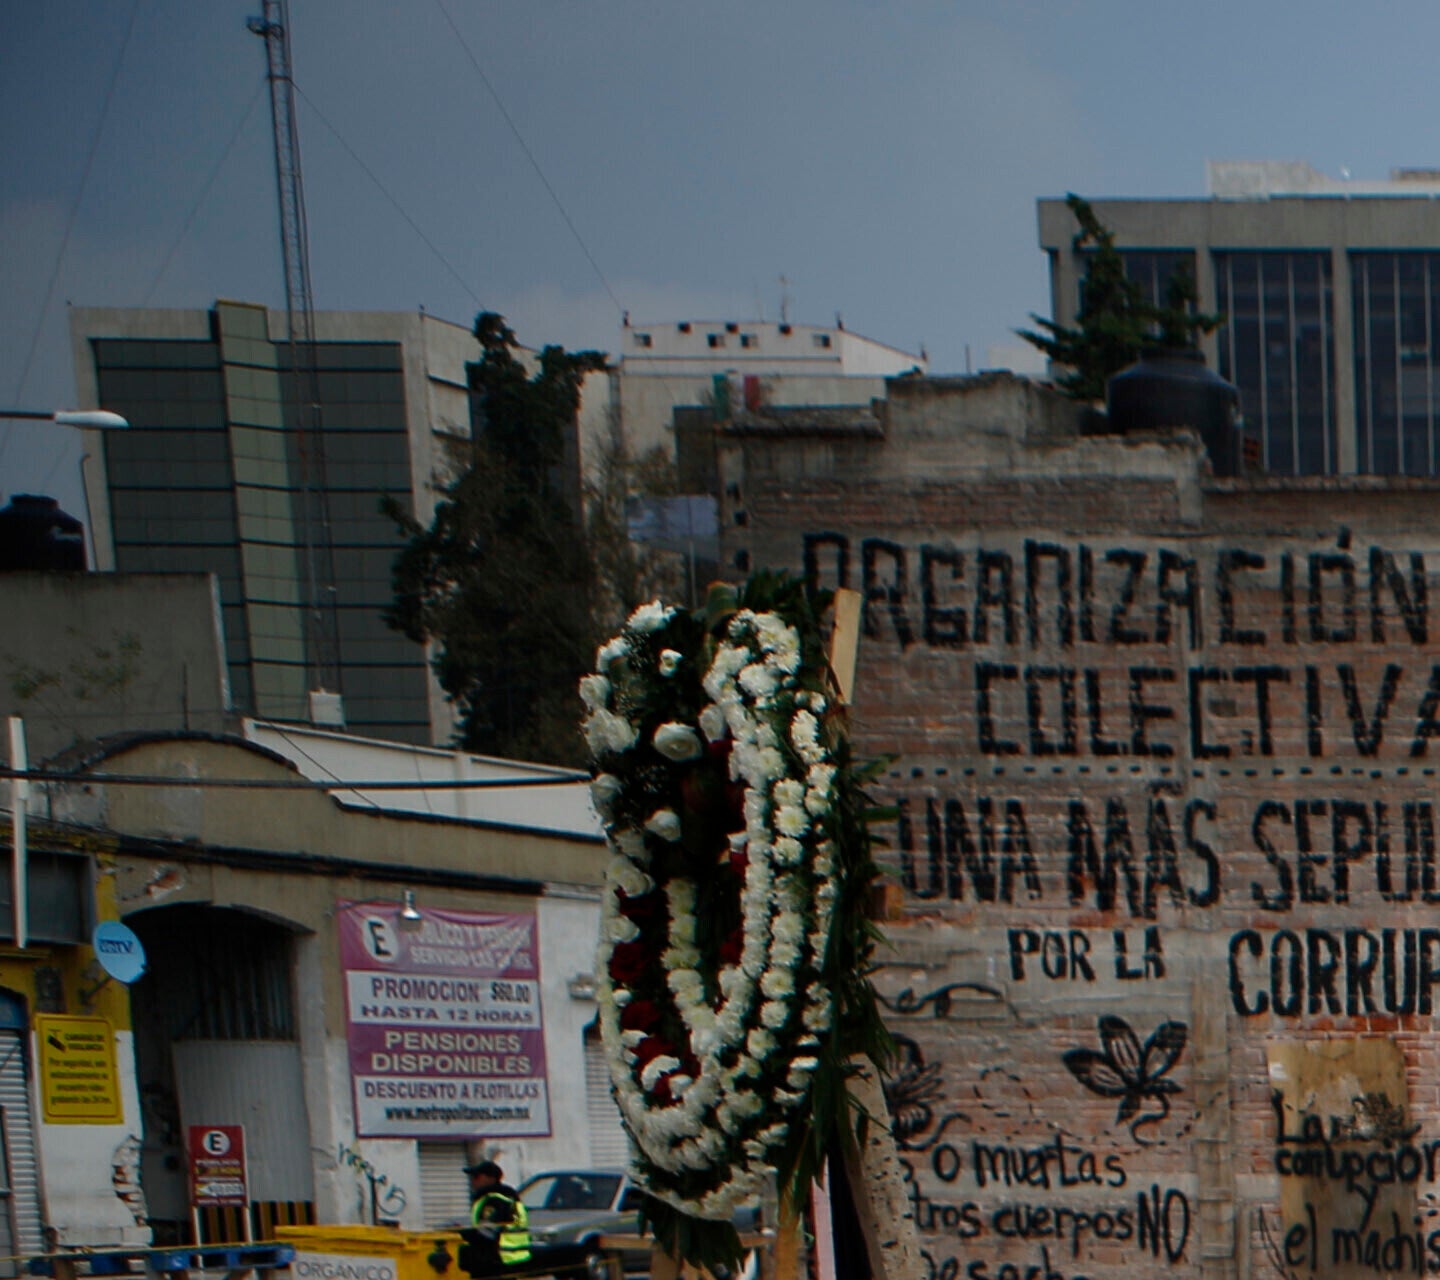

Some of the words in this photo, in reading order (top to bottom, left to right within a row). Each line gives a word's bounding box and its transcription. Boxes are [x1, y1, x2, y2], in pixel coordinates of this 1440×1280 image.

[900, 796, 1042, 901] UNA
[1066, 778, 1223, 917] MÁS
[369, 920, 391, 956] E
[1008, 928, 1094, 981] POR
[1113, 926, 1165, 980] LA
[371, 975, 480, 1003] PROMOCION
[361, 1004, 440, 1021] HASTA
[449, 1009, 470, 1022] 12
[475, 1010, 534, 1023] HORAS
[384, 1030, 522, 1053] PENSIONES
[370, 1052, 532, 1075] DISPONIBLES
[363, 1081, 457, 1100] DESCUENTO
[460, 1083, 471, 1099] A
[473, 1083, 540, 1099] FLOTILLAS
[1272, 1088, 1326, 1144] La
[209, 1133, 223, 1151] E
[972, 1133, 1128, 1190] muertas
[992, 1203, 1134, 1259] cuerpos
[1137, 1183, 1192, 1264] NO
[1284, 1203, 1317, 1271] el
